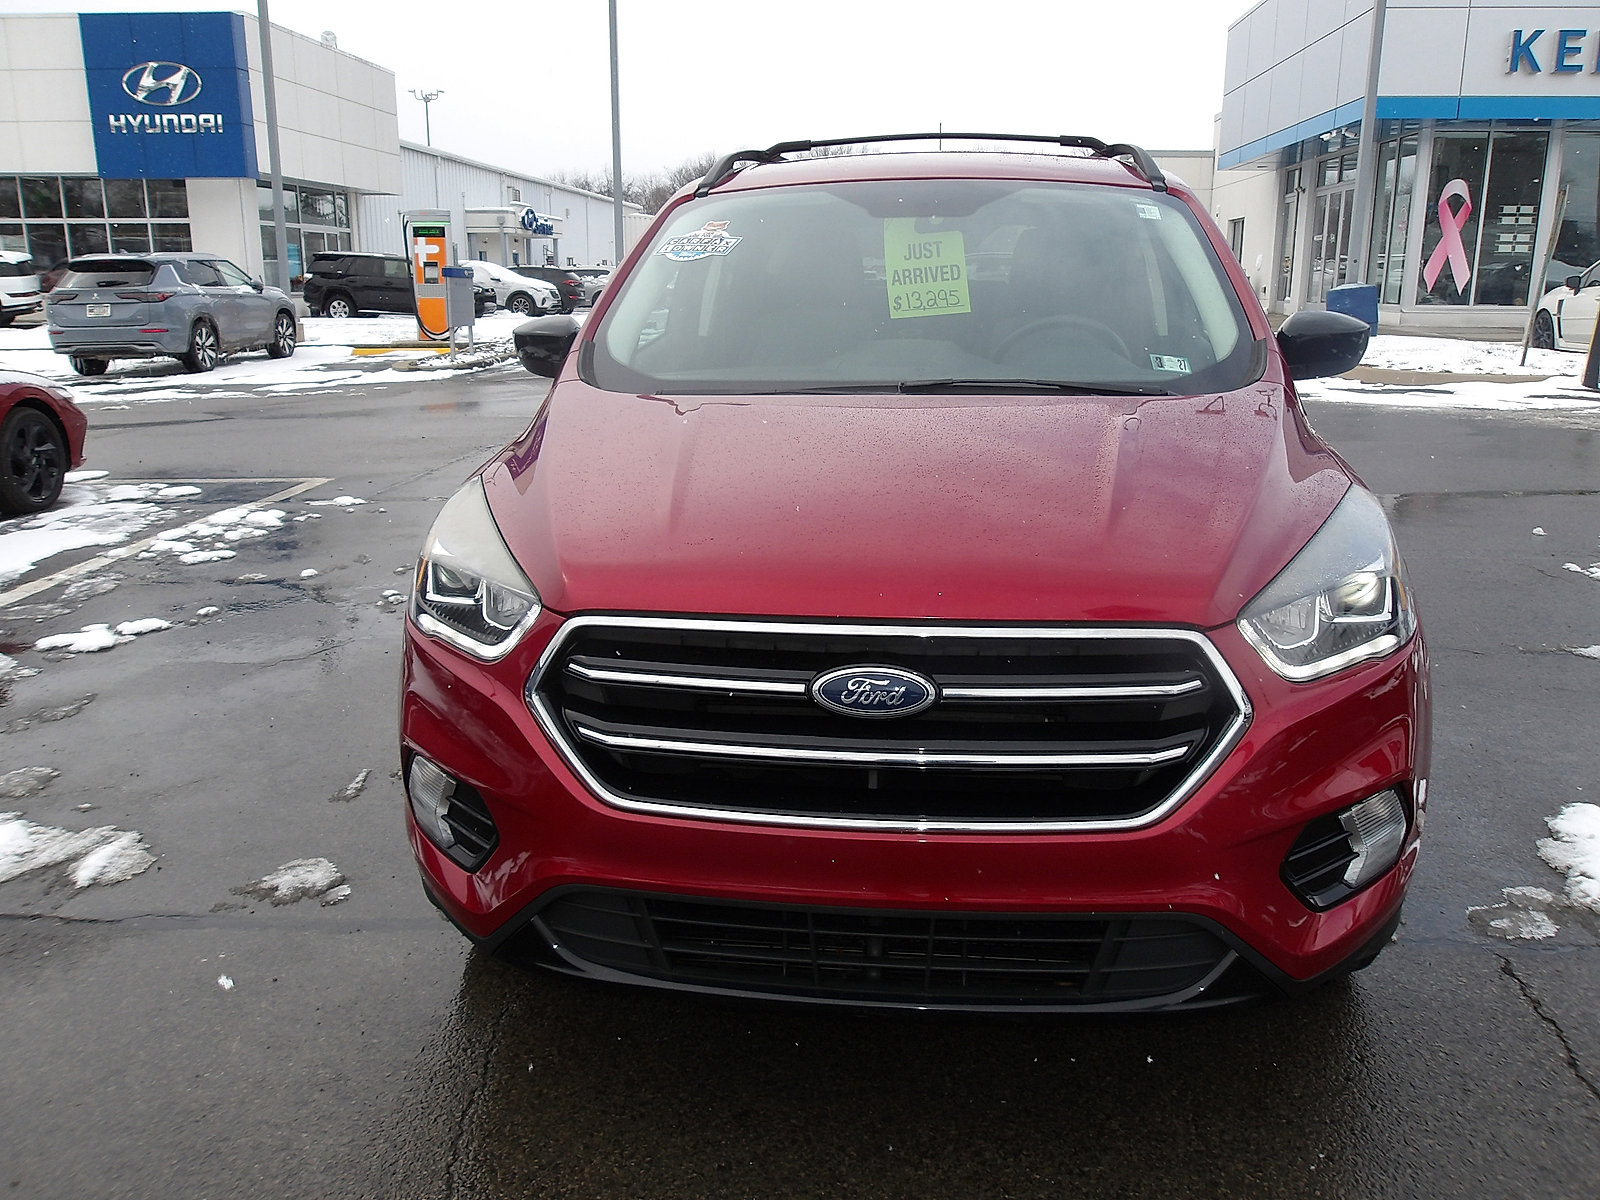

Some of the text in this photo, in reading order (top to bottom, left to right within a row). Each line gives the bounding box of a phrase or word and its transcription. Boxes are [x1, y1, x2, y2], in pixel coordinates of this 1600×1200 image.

[108, 113, 223, 134] HYUNDAI
[904, 241, 942, 260] JUST
[891, 264, 961, 286] ARRIVED
[893, 289, 961, 312] $13,295
[841, 678, 907, 705] Ford
